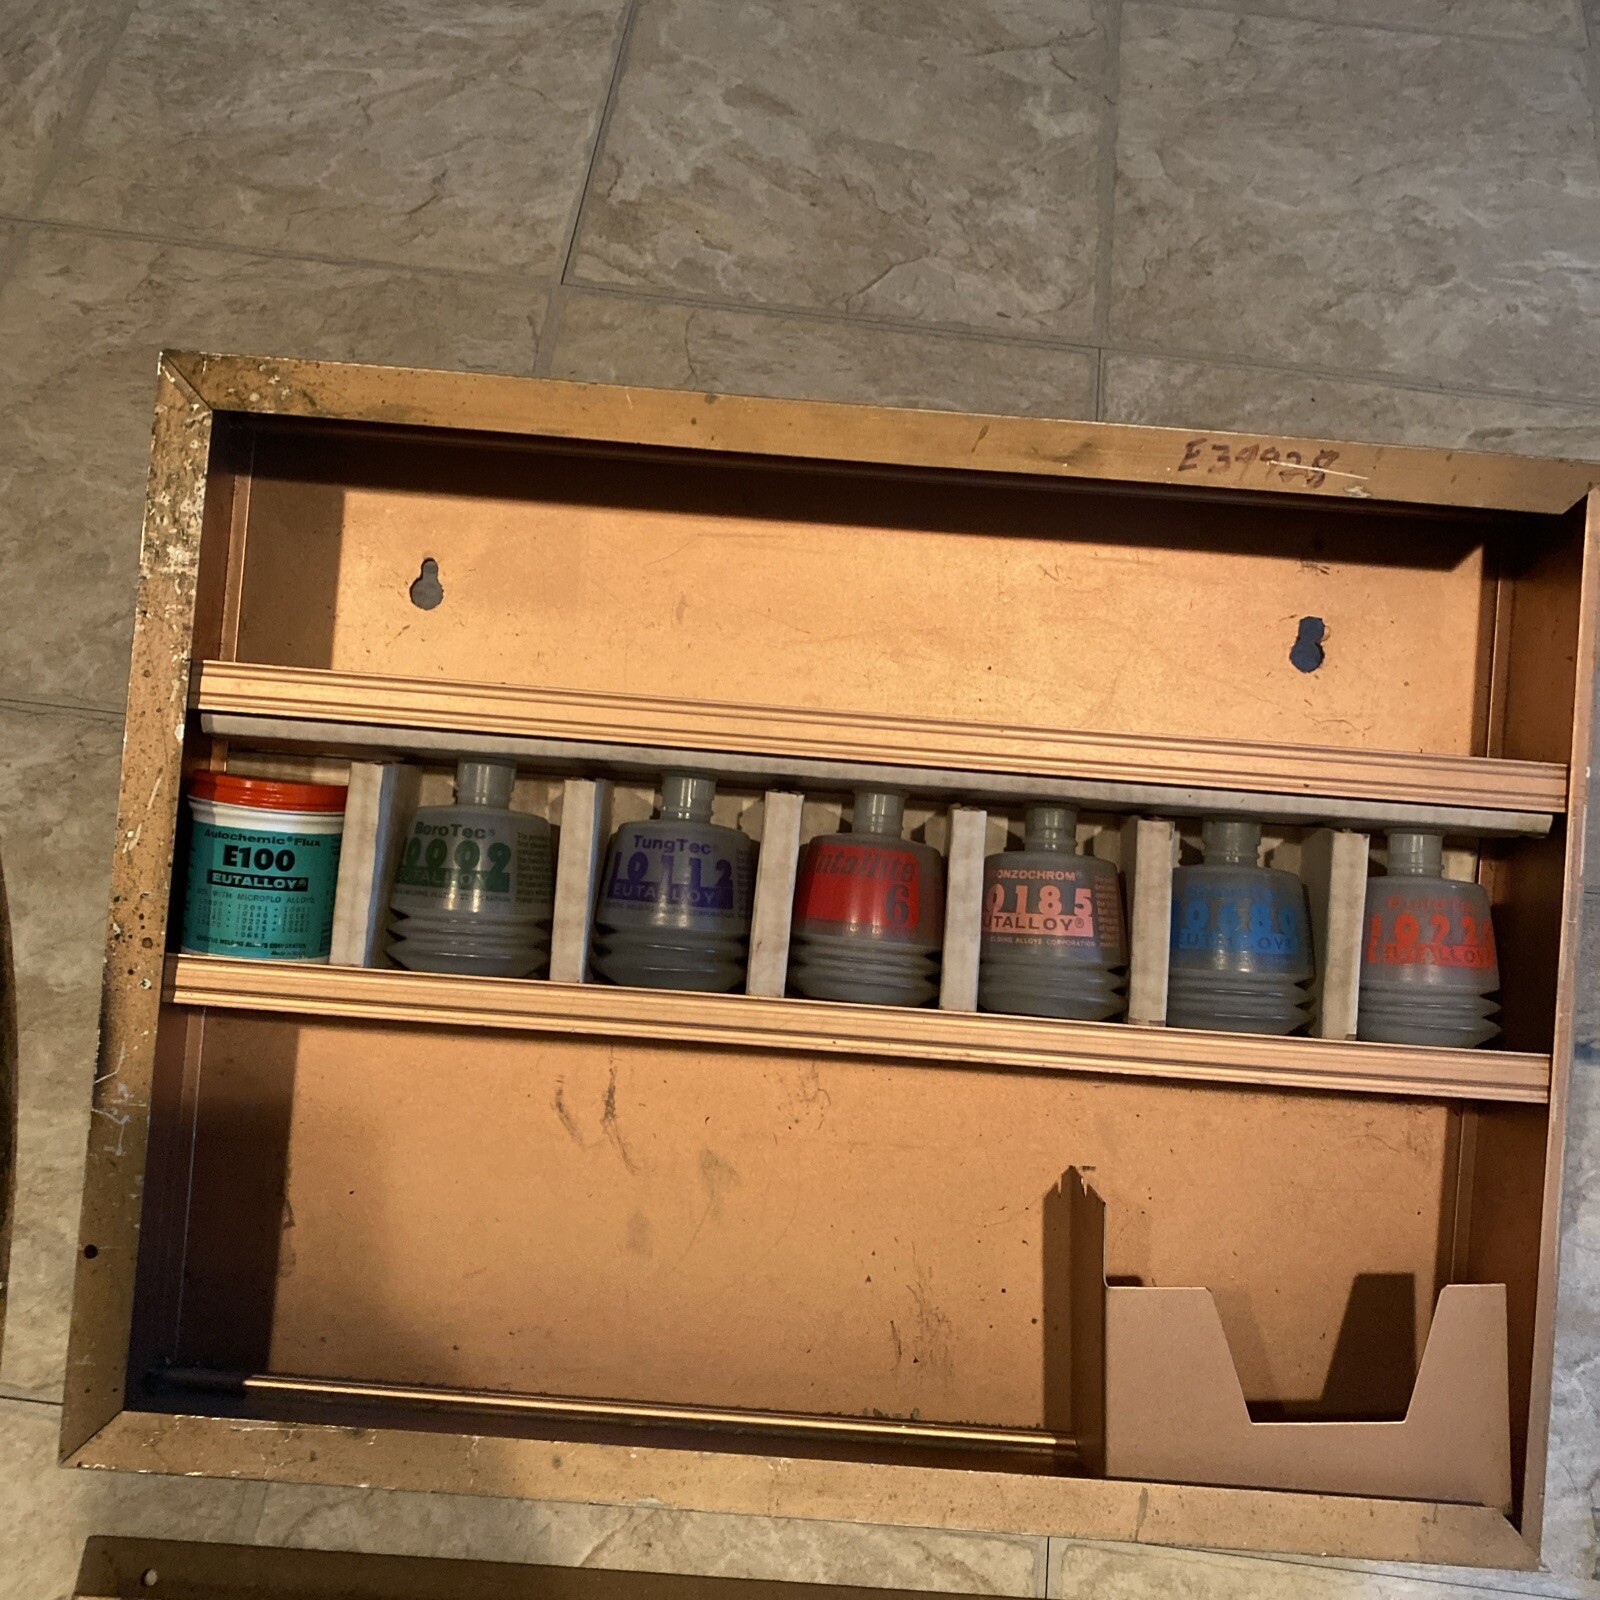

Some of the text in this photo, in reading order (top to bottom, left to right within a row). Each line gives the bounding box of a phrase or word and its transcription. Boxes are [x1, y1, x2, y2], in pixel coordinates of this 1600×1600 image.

[294, 837, 321, 847] Flux
[634, 835, 712, 855] TungTec
[222, 844, 296, 872] E100
[812, 851, 915, 882] utallite
[994, 869, 1077, 881] ONZOCHROM
[237, 892, 281, 903] MICROFLO
[613, 883, 716, 904] EUTALOY
[985, 883, 1093, 916] 0185
[885, 884, 909, 926] 6
